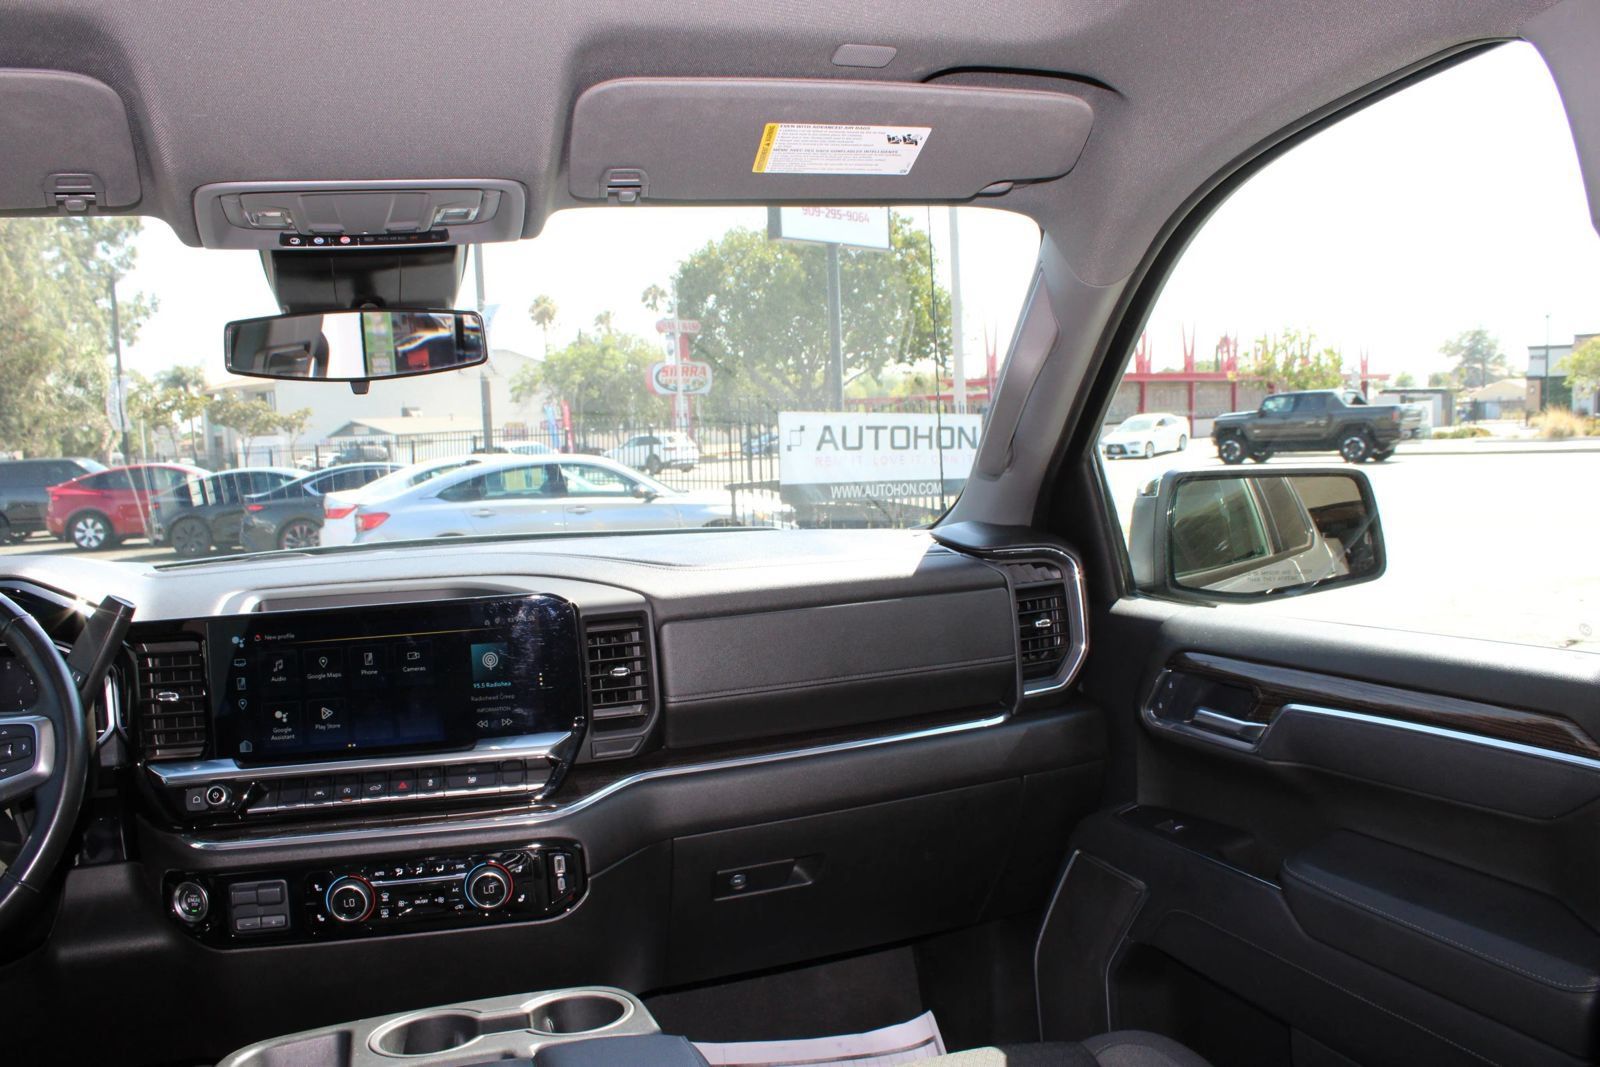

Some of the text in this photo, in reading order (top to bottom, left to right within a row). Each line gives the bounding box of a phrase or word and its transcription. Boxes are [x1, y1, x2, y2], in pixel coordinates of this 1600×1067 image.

[816, 425, 977, 451] AUTOHON
[873, 455, 905, 465] LOVE
[830, 482, 942, 499] WWW.AUTOHON.COM
[277, 632, 295, 641] profile
[402, 665, 426, 673] Cameras
[307, 671, 342, 681] Google Maps
[272, 726, 292, 734] Google
[271, 733, 295, 741] Assistant
